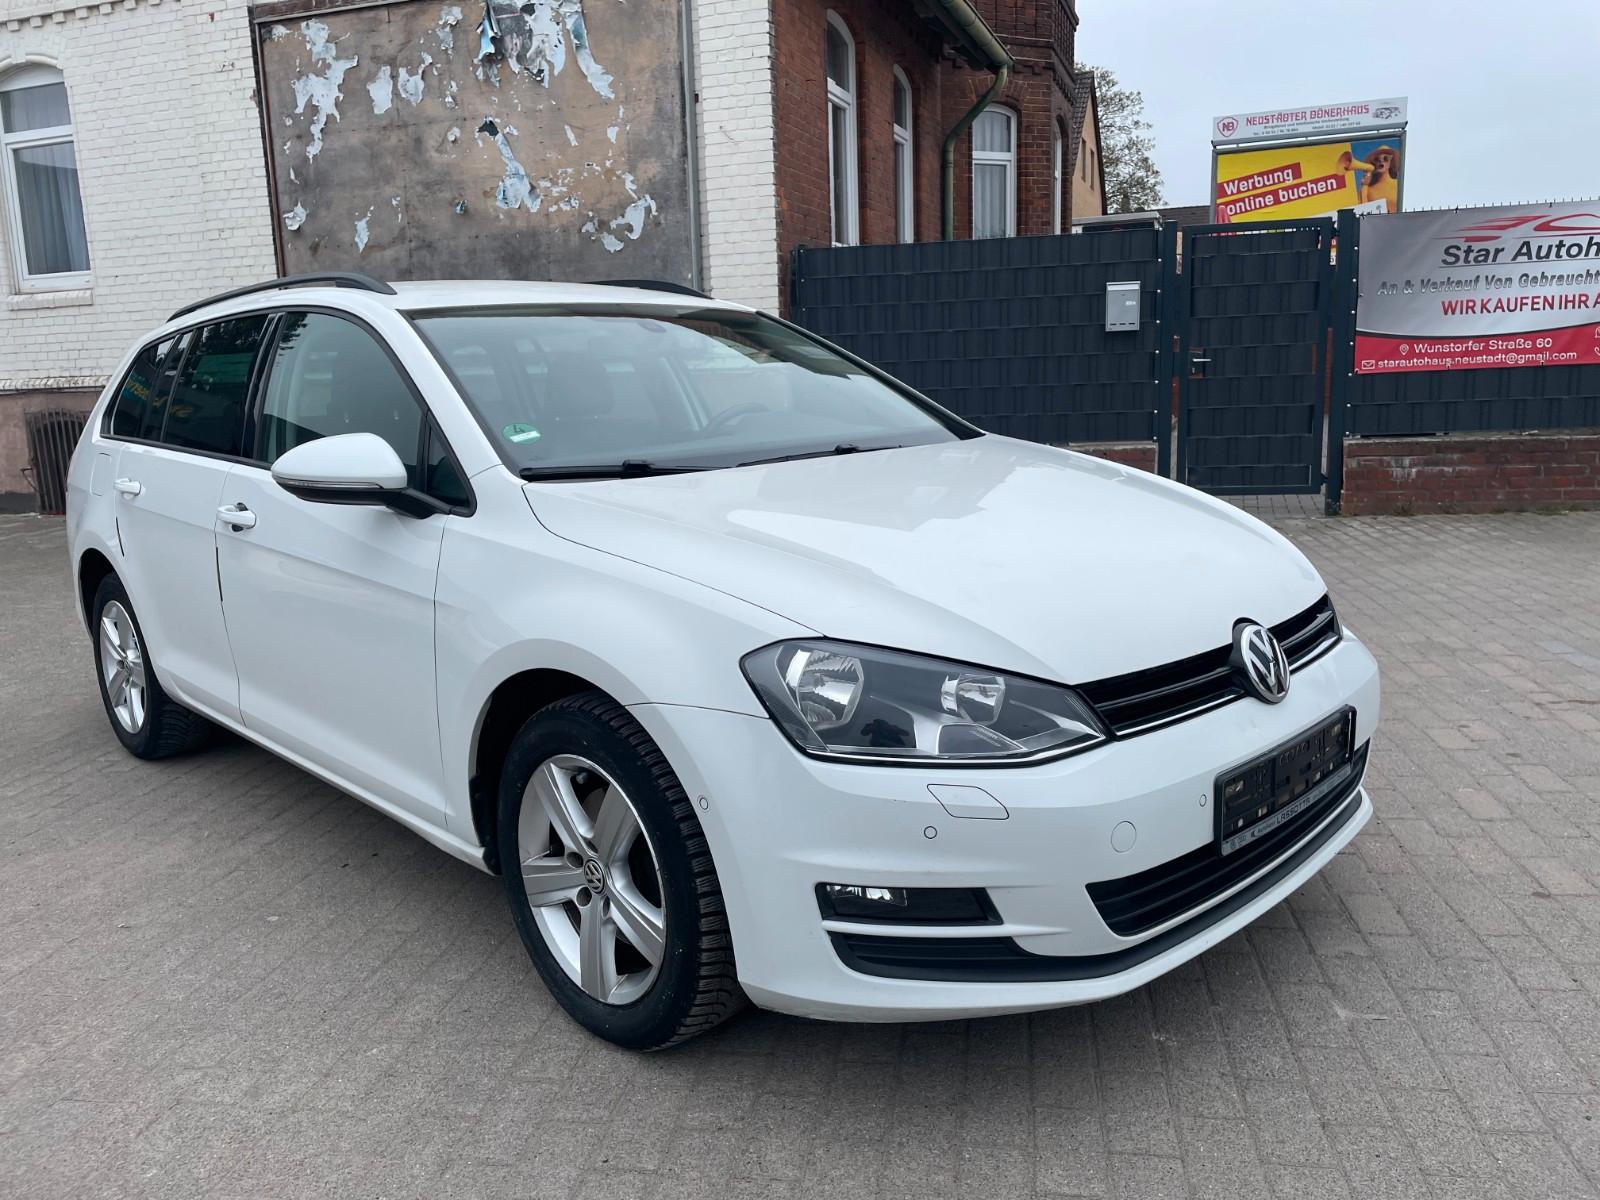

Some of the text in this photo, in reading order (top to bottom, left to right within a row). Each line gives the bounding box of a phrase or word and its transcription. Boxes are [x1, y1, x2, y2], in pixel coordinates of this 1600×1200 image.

[1309, 104, 1370, 120] DÖNERHAUS
[1223, 167, 1293, 196] Werbung
[1227, 177, 1337, 215] online buchen
[1441, 236, 1600, 266] Star Autoh
[1377, 281, 1398, 295] An
[1403, 279, 1414, 294] &
[1420, 274, 1481, 294] Verkauf
[1484, 274, 1513, 290] Von
[1441, 299, 1476, 316] WIR
[1480, 294, 1555, 314] KAUFEN
[1558, 293, 1590, 310] IHR
[1413, 337, 1553, 354] Wunstorfer Straße 60
[1377, 350, 1578, 368] starautohaus.neustadt@gmail.com
